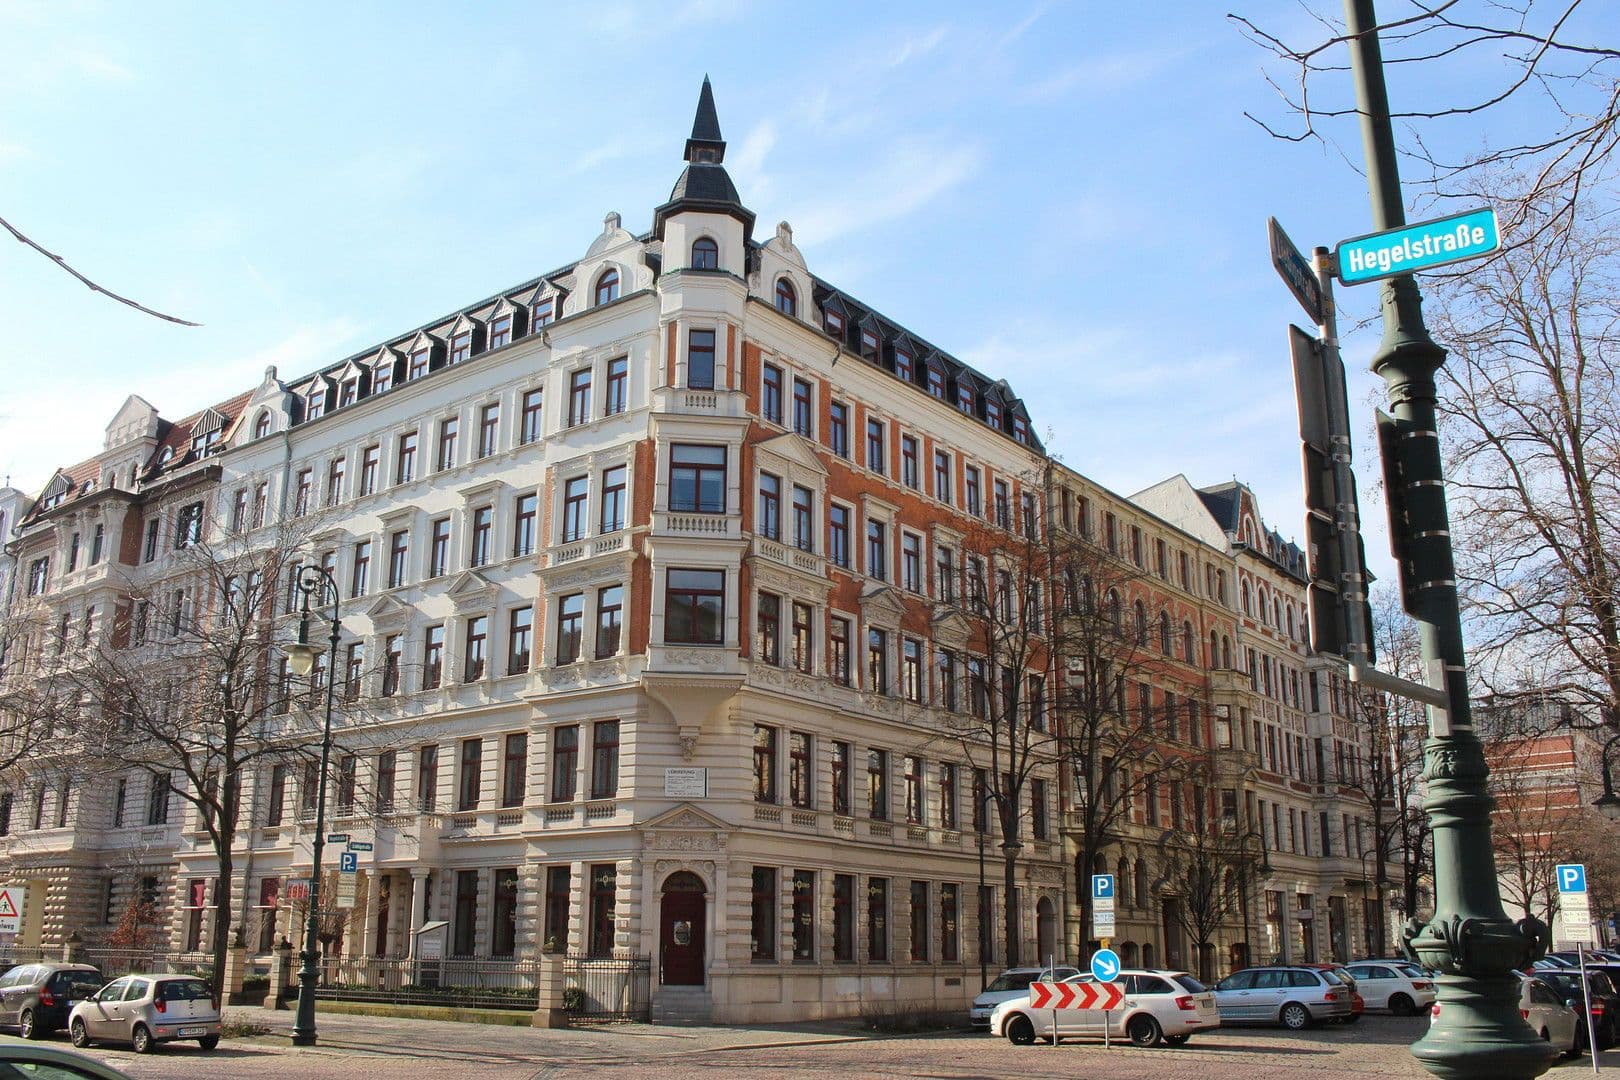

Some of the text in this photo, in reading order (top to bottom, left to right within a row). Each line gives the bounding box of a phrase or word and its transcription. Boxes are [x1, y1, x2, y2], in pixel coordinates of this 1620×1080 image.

[1349, 223, 1486, 272] Hegelstraße
[343, 855, 353, 870] P
[1097, 878, 1109, 896] P
[1563, 868, 1579, 890] P
